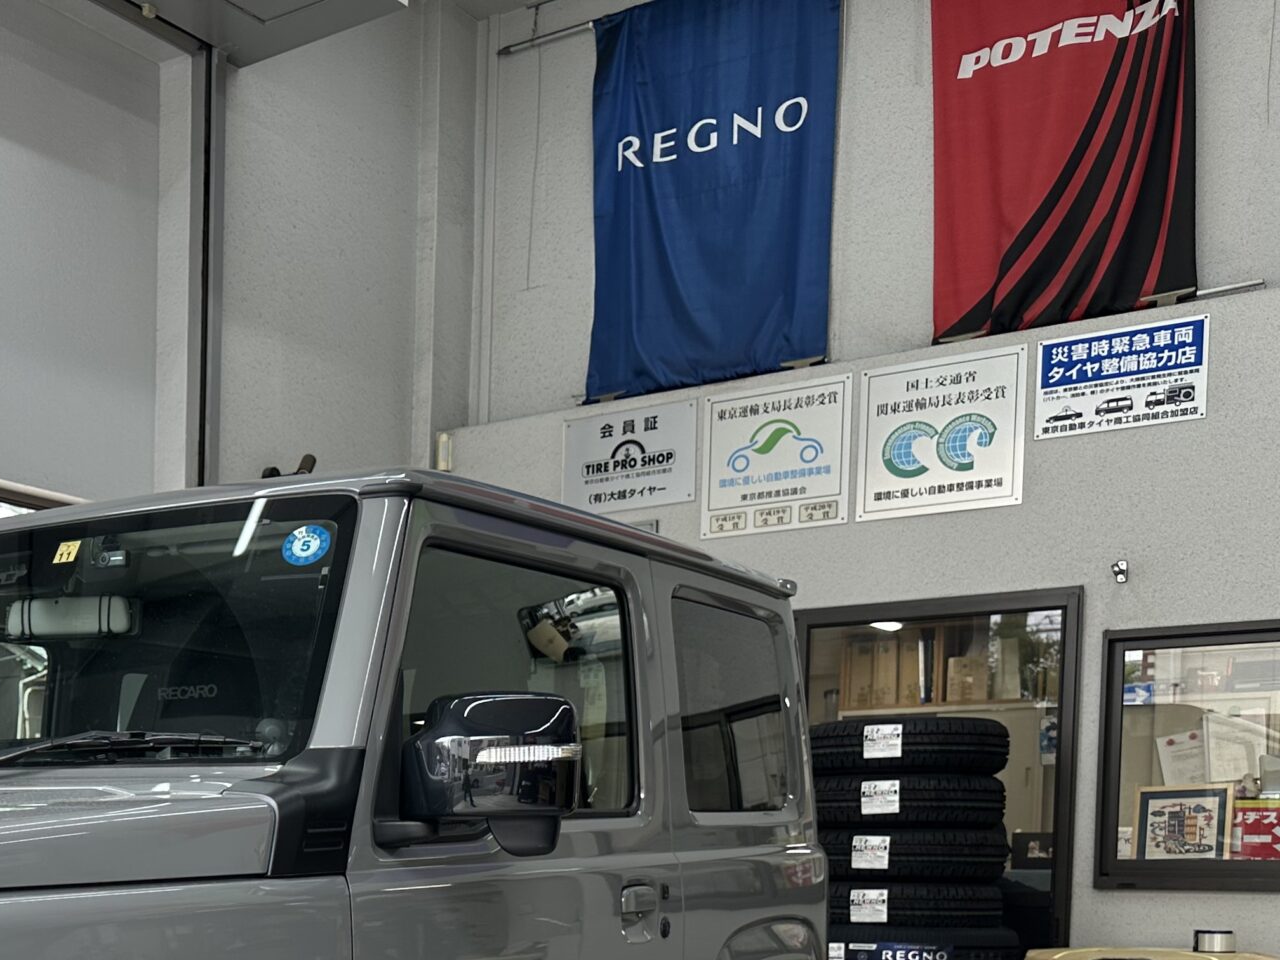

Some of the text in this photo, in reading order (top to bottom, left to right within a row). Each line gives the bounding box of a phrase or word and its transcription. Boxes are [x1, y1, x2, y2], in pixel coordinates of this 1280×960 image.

[616, 96, 809, 172] REGNO
[1050, 325, 1194, 364] 災害時緊急車両
[1047, 346, 1197, 384] タイヤ整備協力店
[906, 370, 977, 392] 国土交通省
[717, 391, 838, 421] 東京運輸支局長表彰受賞
[876, 385, 1007, 417] 関東運輸局長表彰受賞
[600, 415, 658, 439] 会員証
[1041, 406, 1199, 435] 東京自動車タイヤ商工協同組合加盟店
[585, 452, 673, 476] TIRE PRO SHOP
[874, 477, 1003, 502] 環境に優しい自動車整備事業場
[300, 540, 312, 552] 5
[158, 684, 218, 700] RECARO
